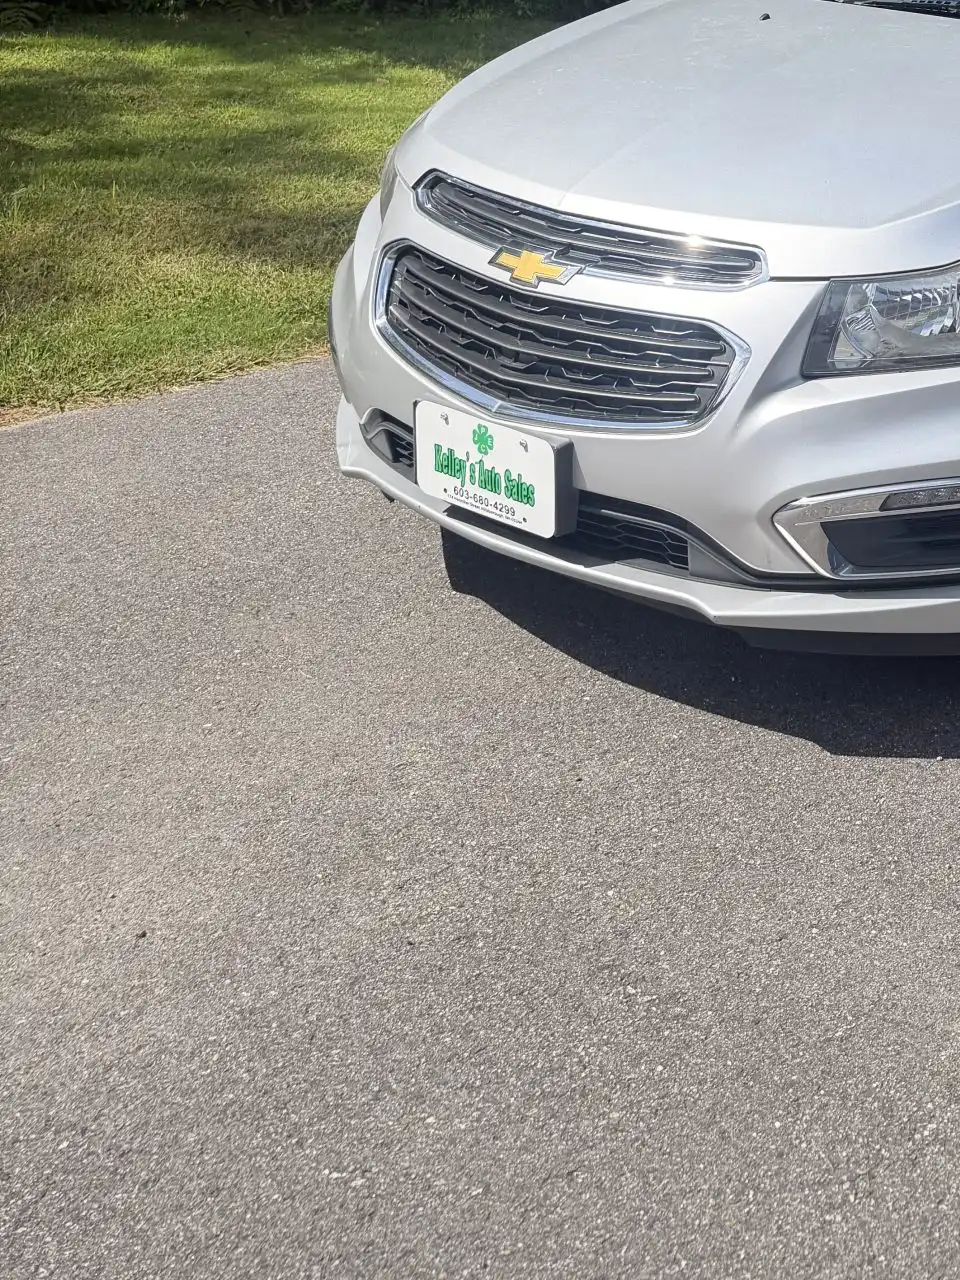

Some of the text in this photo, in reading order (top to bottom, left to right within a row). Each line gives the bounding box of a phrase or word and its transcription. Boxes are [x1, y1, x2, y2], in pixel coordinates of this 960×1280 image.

[434, 443, 535, 507] Kelley's Auto Sales
[453, 486, 516, 517] 603-680-4299
